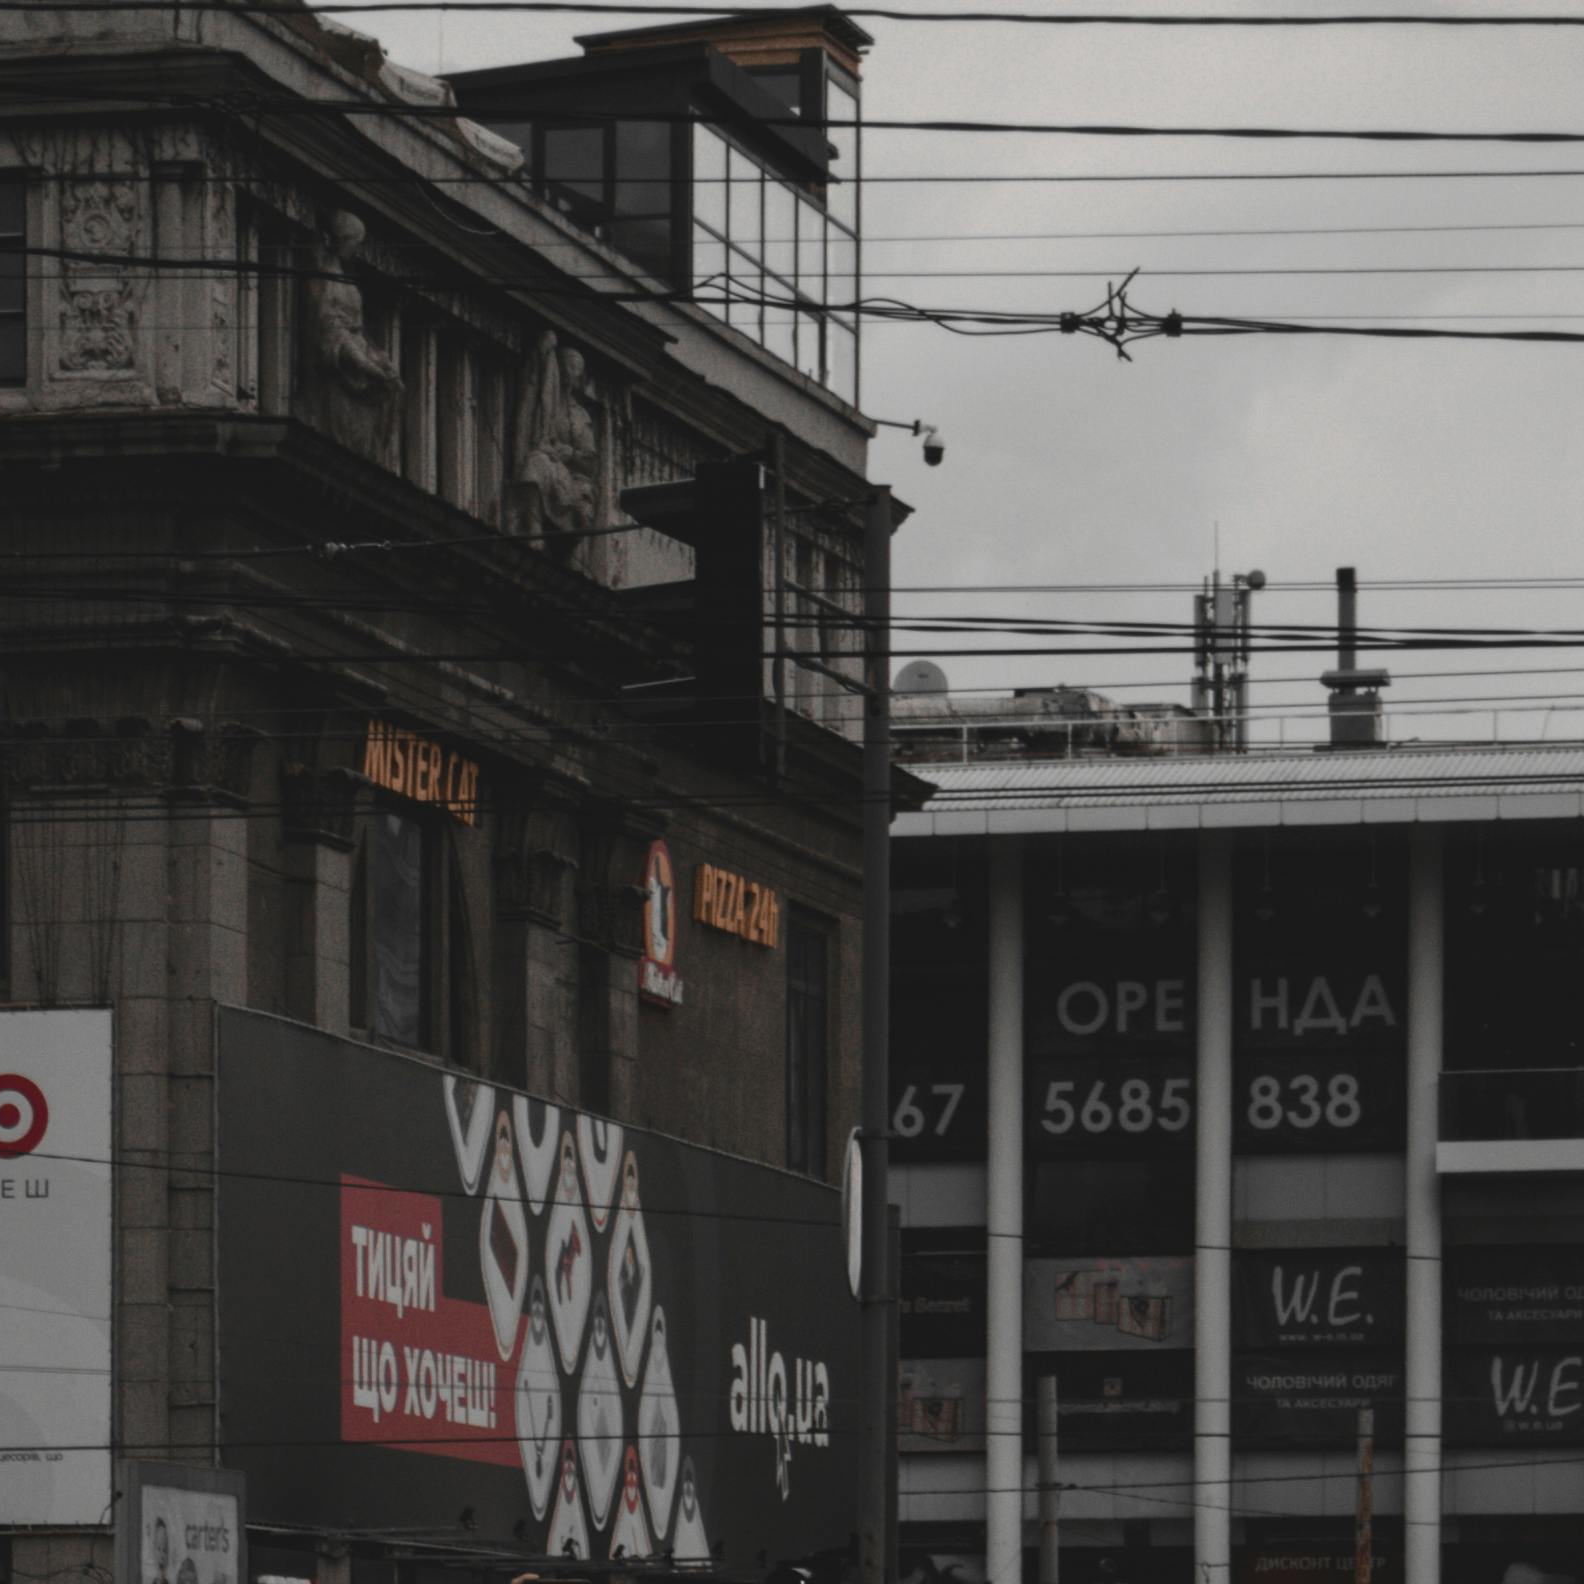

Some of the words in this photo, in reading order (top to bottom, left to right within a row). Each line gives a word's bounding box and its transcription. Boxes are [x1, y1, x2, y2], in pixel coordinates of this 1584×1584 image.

[363, 718, 443, 803] MISTER
[445, 750, 480, 828] CAT
[695, 862, 747, 938] PIZZA
[1040, 1078, 1191, 1135] 5685
[1247, 1073, 1361, 1129] 838
[352, 1222, 435, 1319] ТИЦЯЙ
[352, 1334, 398, 1424] ЩО
[404, 1345, 496, 1429] ХОЧЕШ!
[1246, 1371, 1348, 1390] ЧОЛОВІЧИЙ
[1352, 1373, 1399, 1391] ОДЯГ
[1254, 1556, 1332, 1573] ДИСКОНТ
